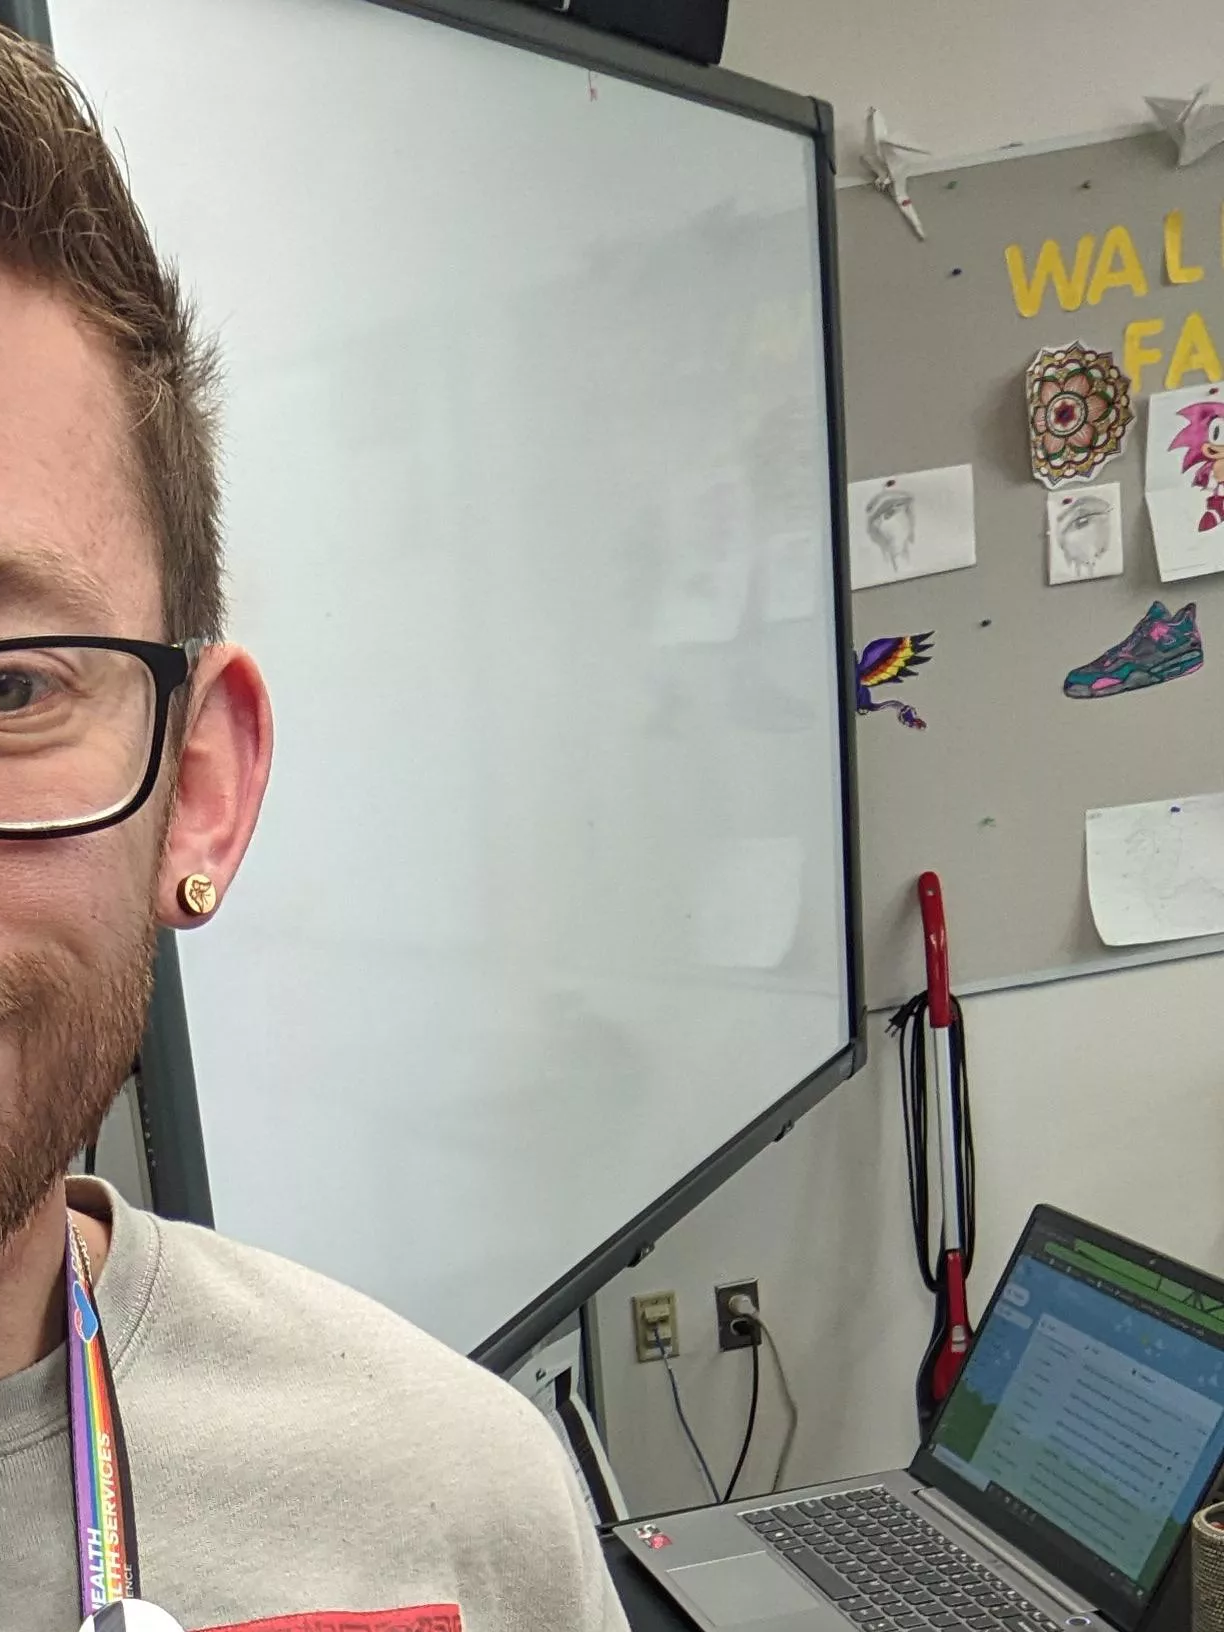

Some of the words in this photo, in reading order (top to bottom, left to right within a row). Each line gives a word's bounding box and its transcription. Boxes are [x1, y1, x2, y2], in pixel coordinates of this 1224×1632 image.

[1005, 206, 1224, 318] WAL
[97, 1432, 120, 1544] SERVICES
[106, 1549, 123, 1601] LTH
[125, 1563, 135, 1599] ENCE
